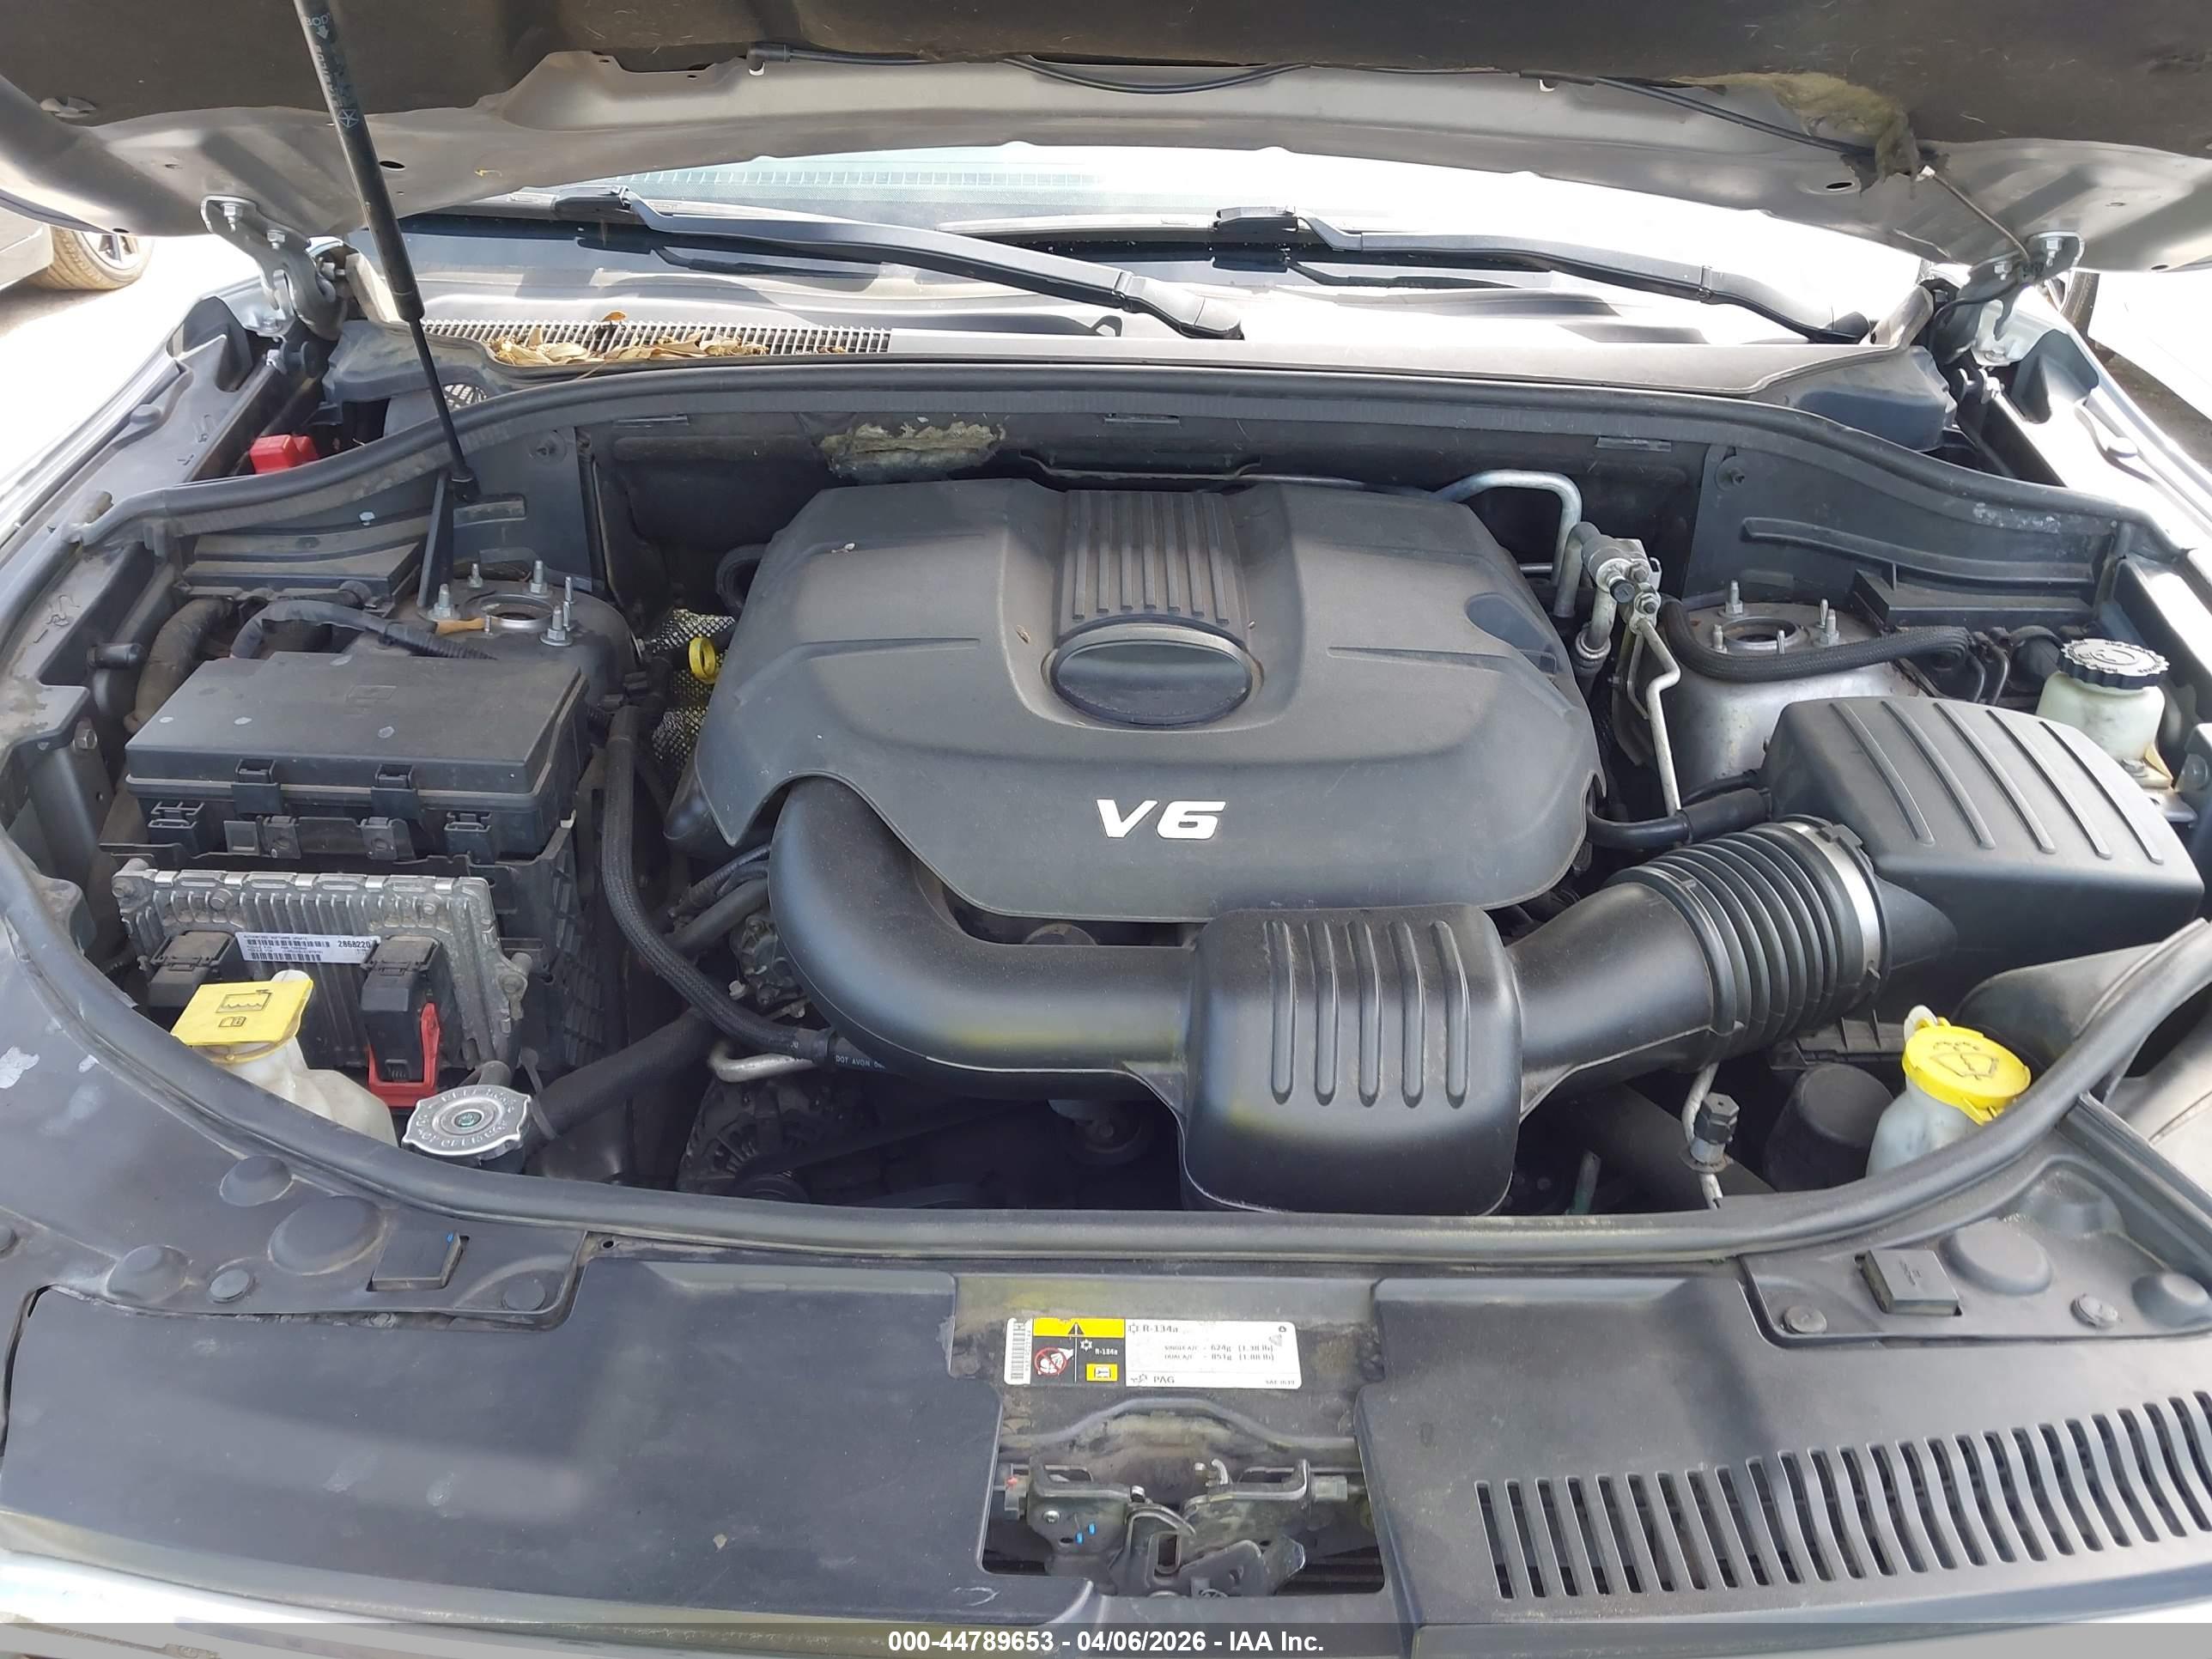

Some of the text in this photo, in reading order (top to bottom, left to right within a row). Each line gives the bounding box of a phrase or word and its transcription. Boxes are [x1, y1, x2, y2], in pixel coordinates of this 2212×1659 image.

[303, 13, 331, 27] BOD
[1097, 799, 1227, 839] V6
[836, 1054, 848, 1064] DOT
[852, 1058, 871, 1066] AVON
[1143, 1324, 1179, 1333] R-134a
[1095, 1347, 1119, 1356] R-134a
